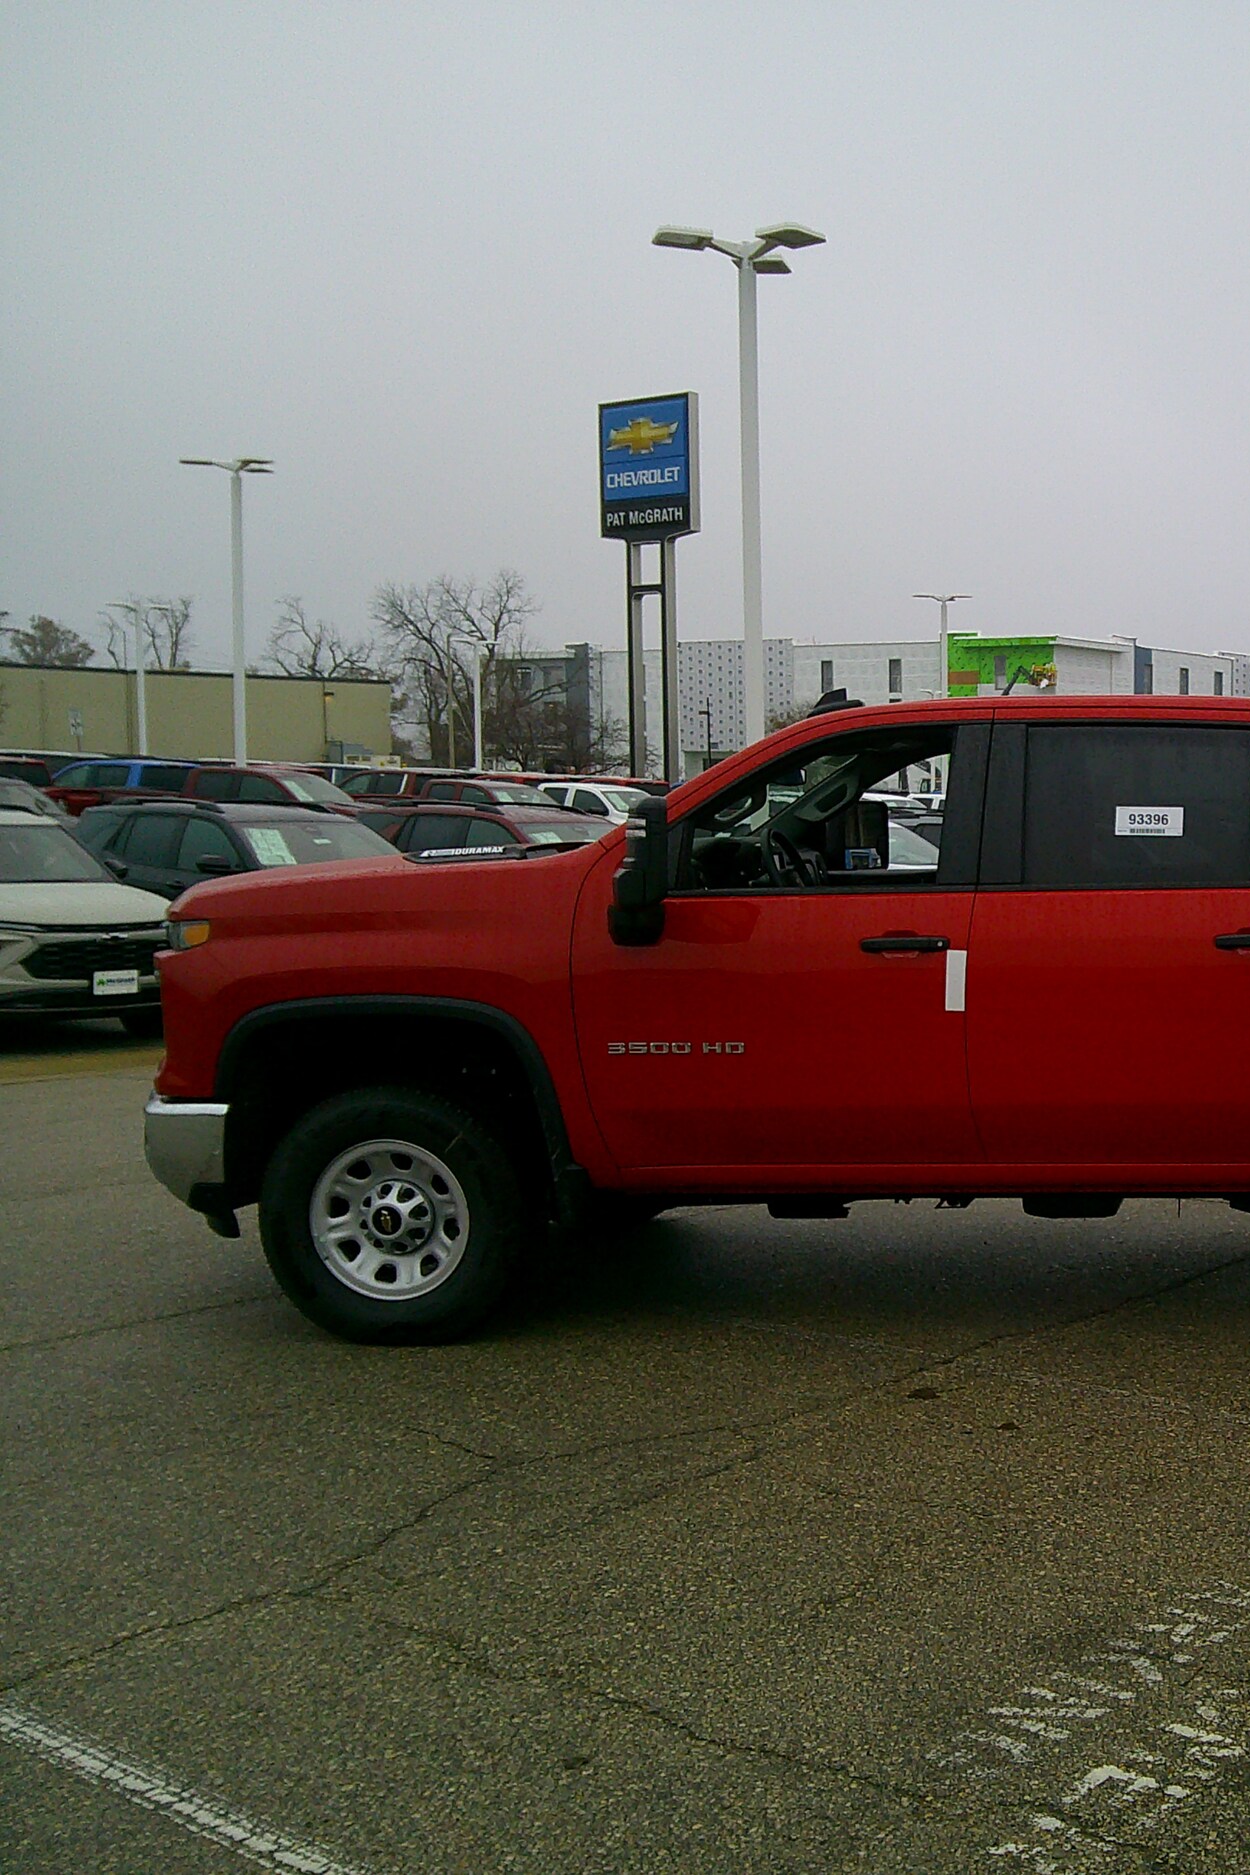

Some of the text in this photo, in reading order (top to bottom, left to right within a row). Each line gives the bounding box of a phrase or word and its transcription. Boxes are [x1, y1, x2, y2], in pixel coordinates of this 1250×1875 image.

[606, 466, 680, 488] CHEVROLET
[606, 507, 683, 527] PAT McGRATH
[1128, 813, 1169, 825] 93396
[453, 846, 505, 855] DURAMAX
[607, 1041, 745, 1055] 3500 HD
